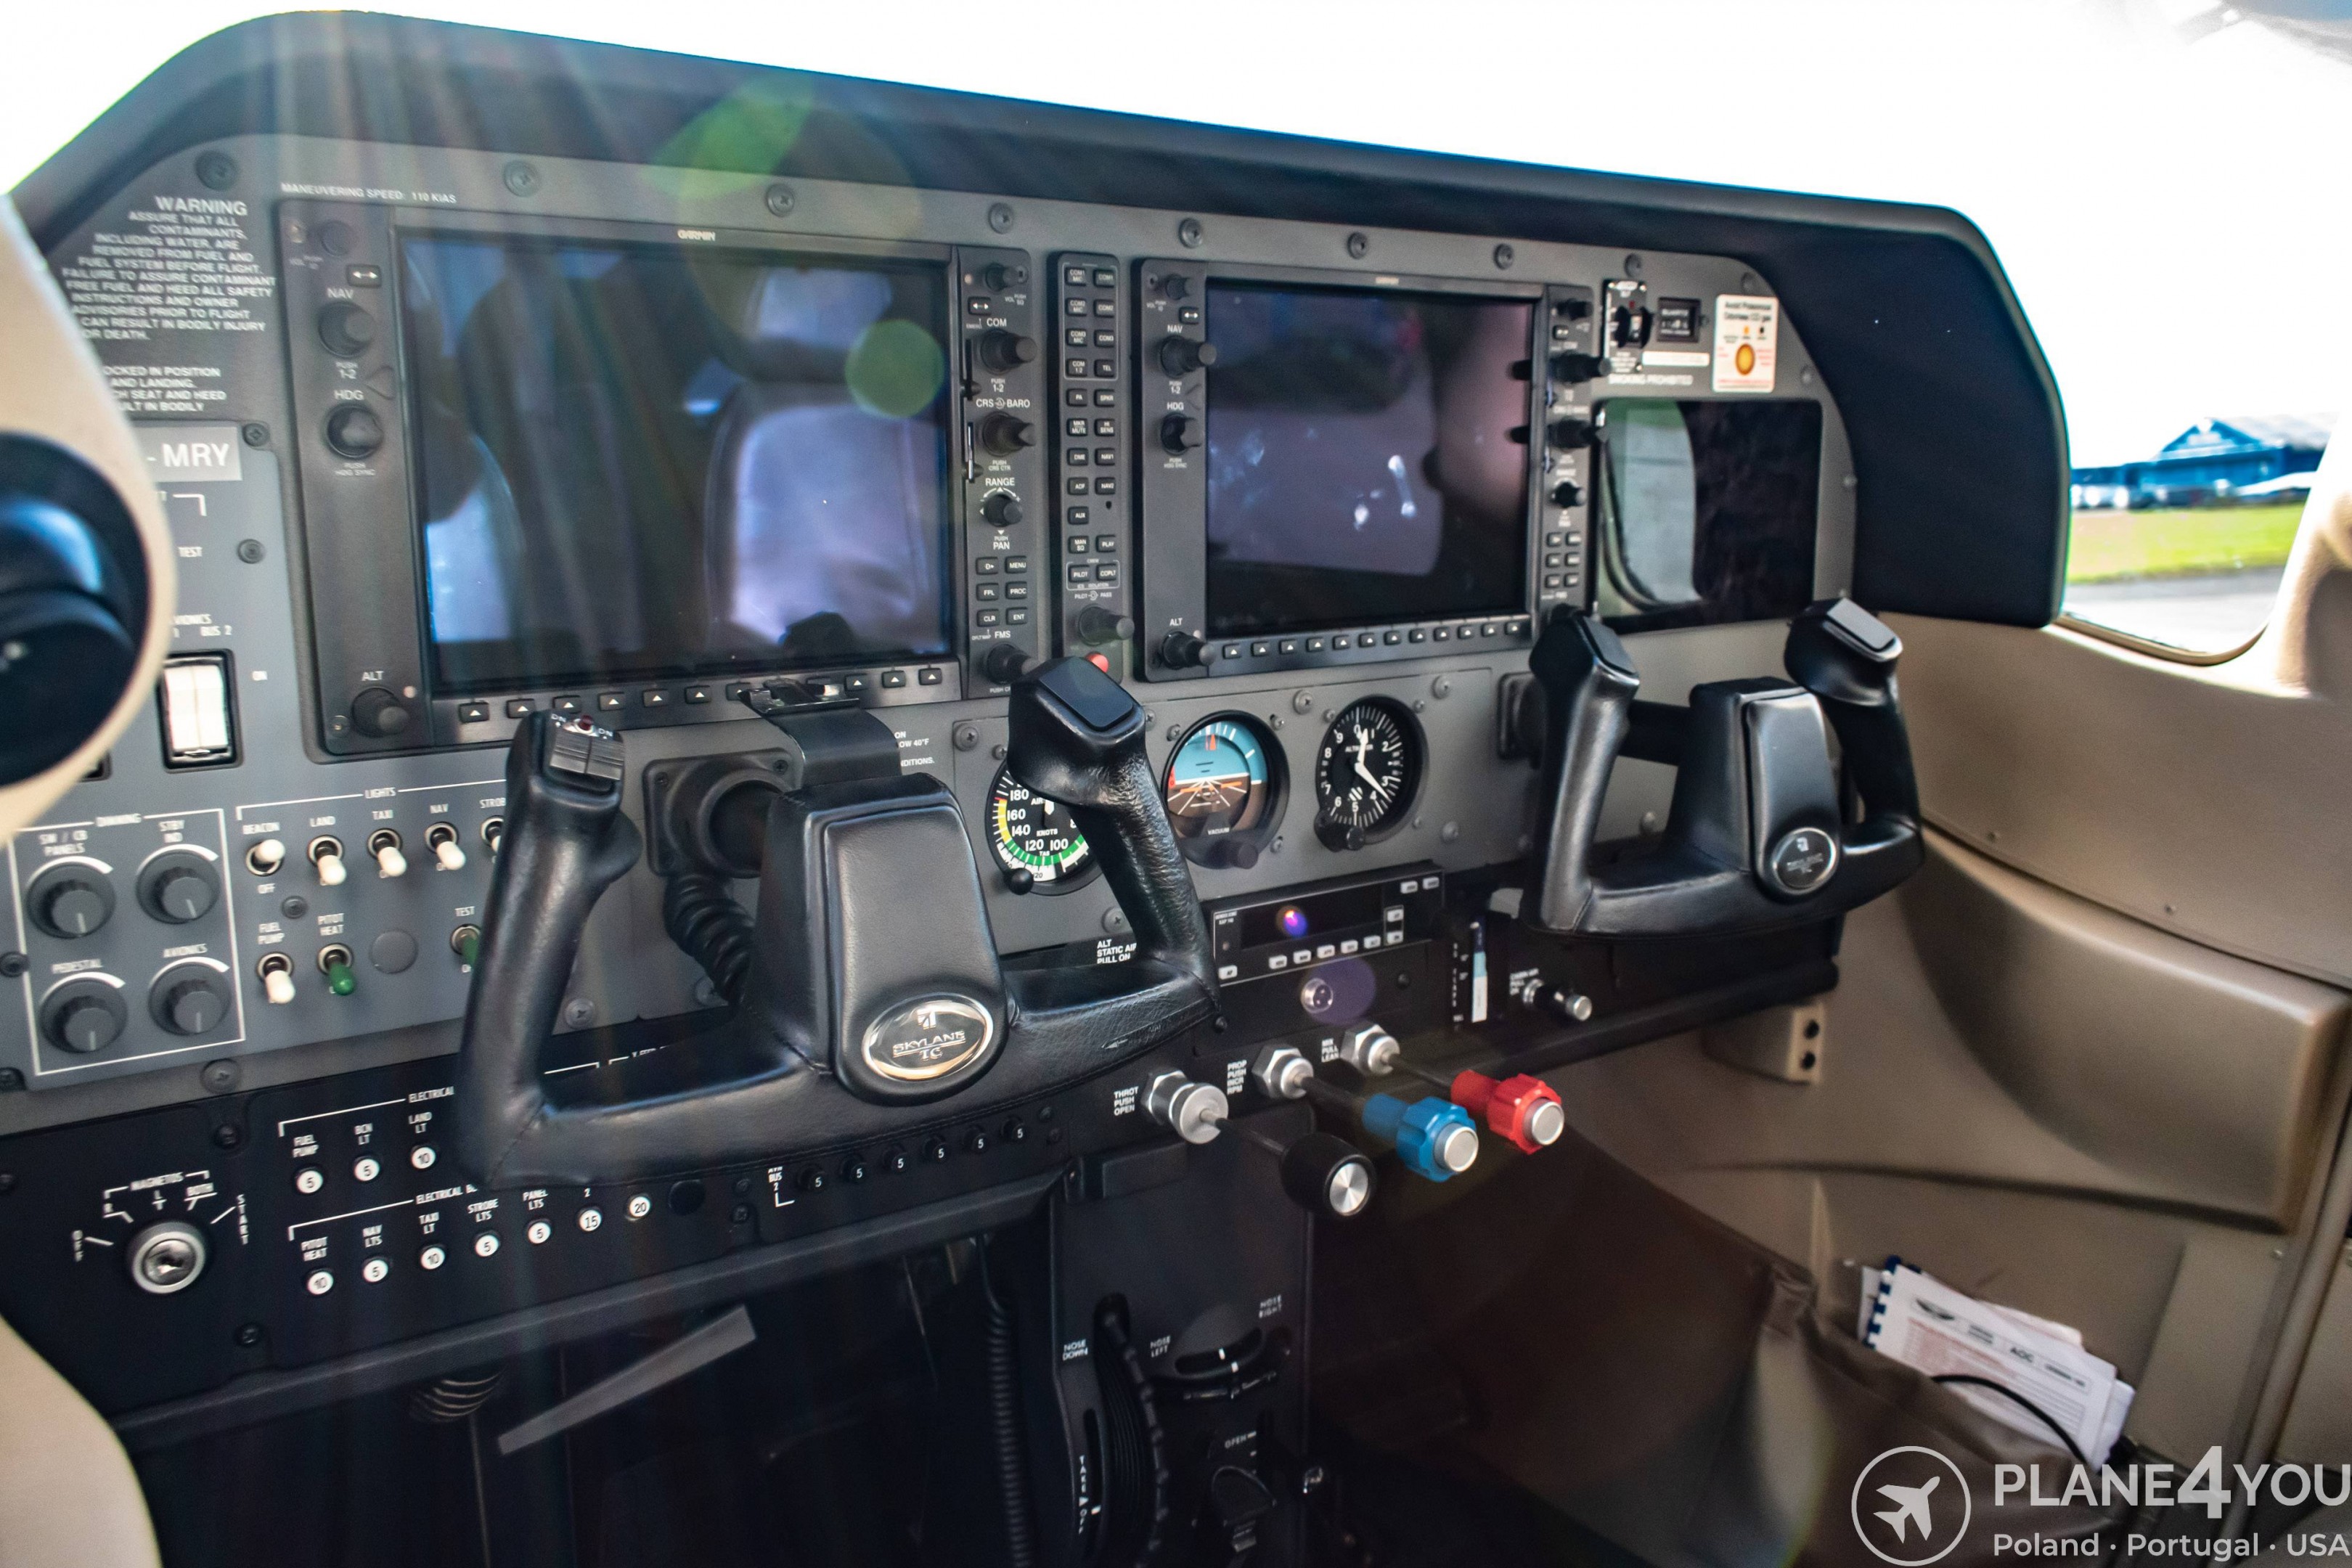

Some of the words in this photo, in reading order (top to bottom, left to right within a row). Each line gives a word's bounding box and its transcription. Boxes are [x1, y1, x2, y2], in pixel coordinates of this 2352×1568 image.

[281, 182, 364, 198] MANEUVERING
[412, 192, 430, 201] 110
[432, 193, 457, 203] KIAS
[155, 196, 248, 216] WARNING
[182, 214, 213, 225] THAT
[216, 216, 239, 226] ALL
[92, 245, 155, 258] REMOVED
[194, 250, 226, 261] FUEL
[228, 252, 254, 262] AND
[78, 256, 111, 268] FUEL
[118, 270, 137, 280] TO
[139, 271, 189, 283] ASSURE
[191, 274, 276, 286] CONTAMINANT
[137, 283, 164, 293] AND
[202, 286, 224, 295] ALL
[226, 286, 272, 297] SAFETY
[327, 288, 354, 299] NAV
[71, 293, 163, 304] INSTRUCTIONS
[166, 296, 191, 306] AND
[193, 298, 239, 307] OWNER
[149, 306, 187, 317] PRIOR
[189, 308, 207, 318] TO
[208, 309, 250, 319] FLIGHT
[80, 317, 108, 327] CAN
[111, 318, 160, 328] RESULT
[176, 319, 221, 330] BODILY
[223, 322, 266, 331] INJURY
[987, 318, 1007, 327] COM
[163, 367, 221, 377] POSITION
[111, 378, 137, 387] AND
[131, 390, 163, 399] SEAT
[165, 391, 192, 399] AND
[193, 391, 227, 400] HEED
[334, 390, 364, 401] HDG
[160, 402, 204, 412] BODILY
[976, 399, 994, 408] CRS
[1007, 399, 1031, 408] BARO
[985, 478, 1015, 486] RANGE
[179, 547, 203, 558] TEST
[1169, 617, 1183, 626] ALT
[362, 671, 383, 681] ALT
[552, 714, 566, 722] DN
[598, 728, 613, 737] DN
[1336, 732, 1343, 743] 9
[1325, 748, 1331, 759] 8
[364, 788, 396, 799] LIGHTS
[1010, 789, 1029, 801] 180
[1325, 784, 1331, 795] 7
[1334, 796, 1342, 807] 6
[1352, 802, 1359, 812] 5
[372, 809, 393, 820] TAXI
[430, 804, 448, 814] NAV
[1007, 809, 1026, 821] 160
[309, 816, 335, 827] LAND
[242, 822, 280, 834] BEACON
[1012, 825, 1031, 837] 140
[1208, 827, 1230, 836] VACUUM
[1025, 839, 1044, 852] 120
[1050, 838, 1069, 851] 100
[44, 844, 86, 857] PANELS
[257, 883, 276, 894] OFF
[454, 906, 475, 916] TEST
[317, 913, 344, 925] PITOT
[258, 922, 281, 933] FUEL
[320, 925, 344, 936] HEAT
[258, 933, 285, 944] PUMP
[1097, 939, 1111, 949] ALT
[163, 944, 208, 958] AVIONICS
[1097, 946, 1124, 957] STATIC
[1097, 955, 1117, 964] PULL
[1119, 952, 1130, 962] ON
[892, 1030, 965, 1051] SKYLANE
[1322, 1038, 1334, 1047] MIX
[920, 1048, 942, 1061] TC
[1322, 1046, 1339, 1055] PULL
[1228, 1060, 1247, 1071] PROP
[1227, 1069, 1246, 1079] PUSH
[409, 1086, 454, 1103] ELECTRICAL
[1114, 1086, 1139, 1099] THROT
[1114, 1096, 1135, 1107] PUSH
[1114, 1105, 1135, 1116] OPEN
[408, 1112, 432, 1124] LAND
[354, 1123, 373, 1135] BCN
[415, 1124, 427, 1133] LT
[294, 1135, 317, 1146] FUEL
[358, 1134, 371, 1145] LT
[293, 1145, 319, 1158] PUMP
[417, 1153, 430, 1164] 10
[307, 1177, 314, 1188] 5
[768, 1172, 783, 1183] BUS
[416, 1186, 463, 1204] ELECTRICAL
[523, 1190, 548, 1201] PANEL
[467, 1199, 499, 1214] STROBE
[528, 1199, 544, 1210] LTS
[634, 1201, 647, 1213] 20
[237, 1194, 248, 1245] START
[419, 1212, 439, 1224] TAXI
[475, 1211, 491, 1222] LTS
[585, 1214, 599, 1228] 15
[363, 1225, 383, 1237] NAV
[423, 1223, 435, 1234] LT
[301, 1236, 327, 1251] PITOT
[365, 1236, 383, 1248] LTS
[303, 1247, 327, 1261] HEAT
[428, 1253, 439, 1265] 10
[314, 1277, 327, 1289] 10
[1259, 1295, 1281, 1308] NOSE
[1063, 1339, 1087, 1351] NOSE
[1150, 1335, 1171, 1349] NOSE
[1062, 1347, 1088, 1360] DOWN
[1151, 1344, 1169, 1357] LEFT
[1225, 1434, 1247, 1448] OPEN
